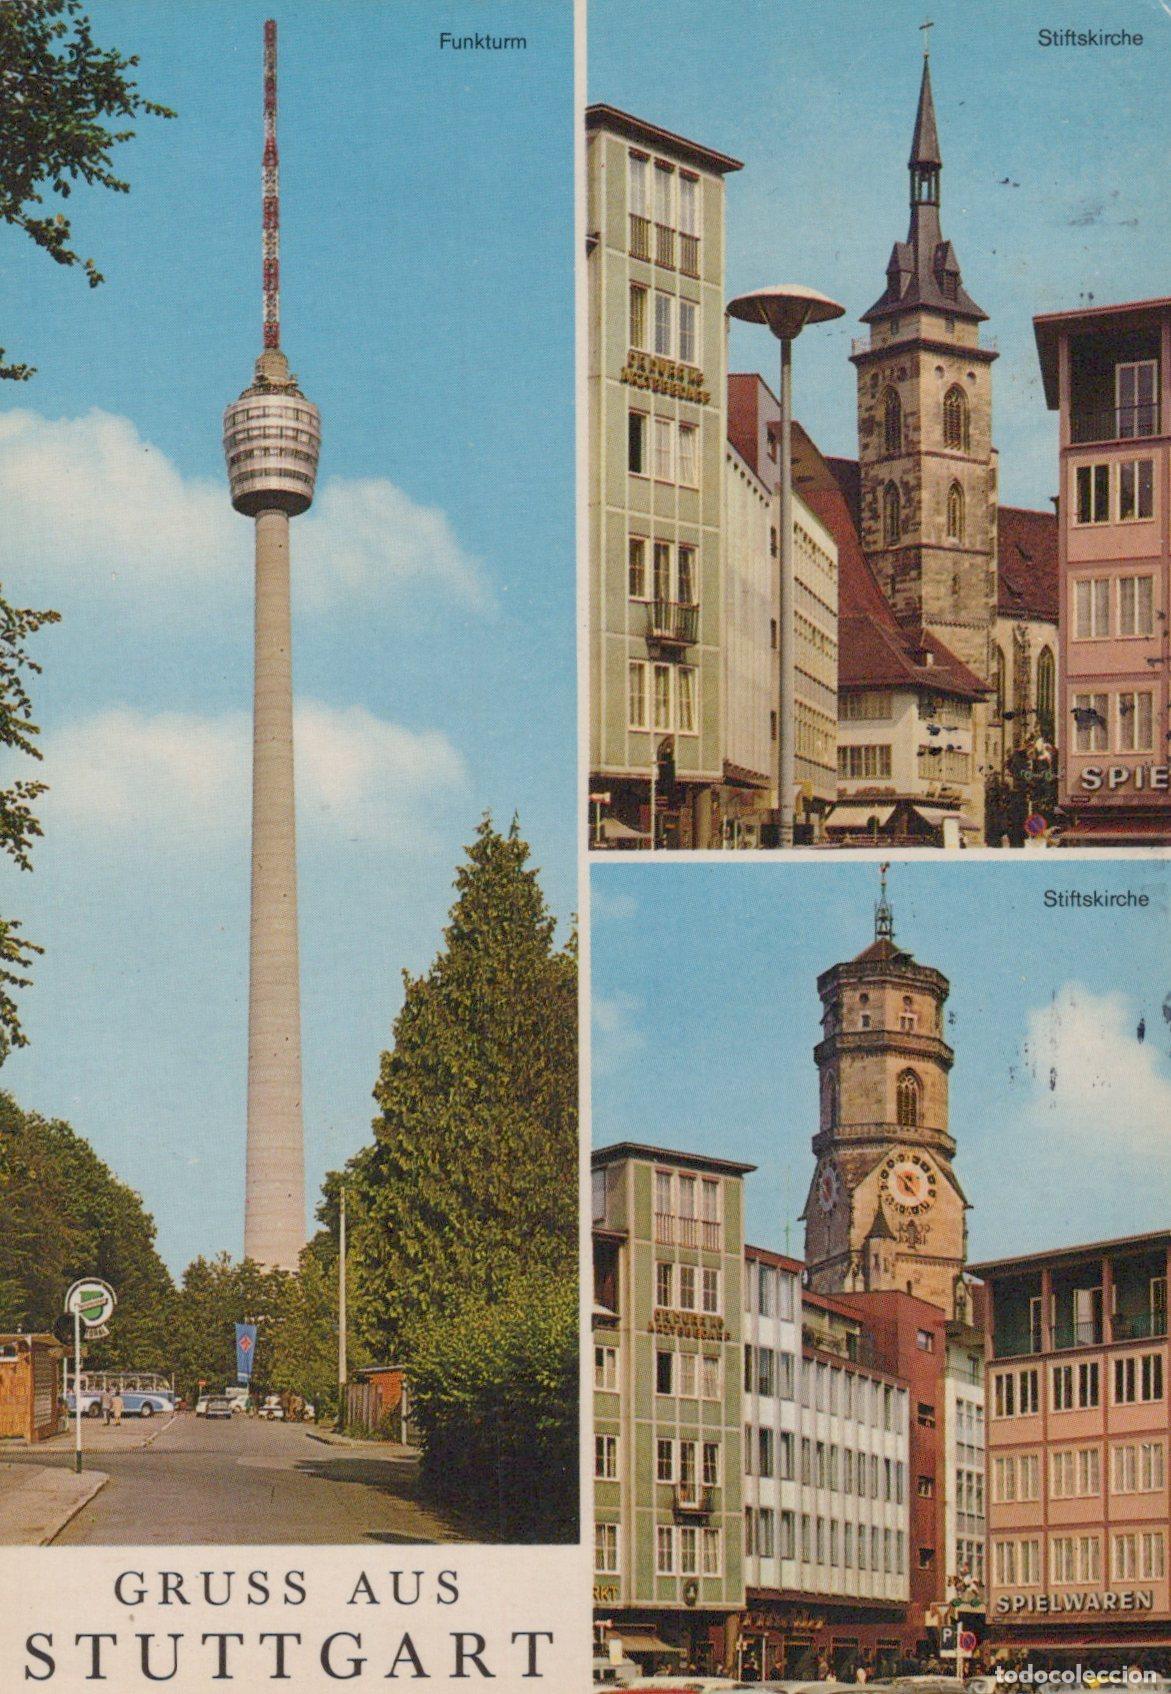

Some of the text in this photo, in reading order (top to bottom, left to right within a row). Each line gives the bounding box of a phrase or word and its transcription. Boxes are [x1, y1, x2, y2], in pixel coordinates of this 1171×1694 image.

[1080, 765, 1169, 790] SPIE
[996, 1590, 1154, 1613] SPIELWAREN
[943, 1627, 953, 1643] P
